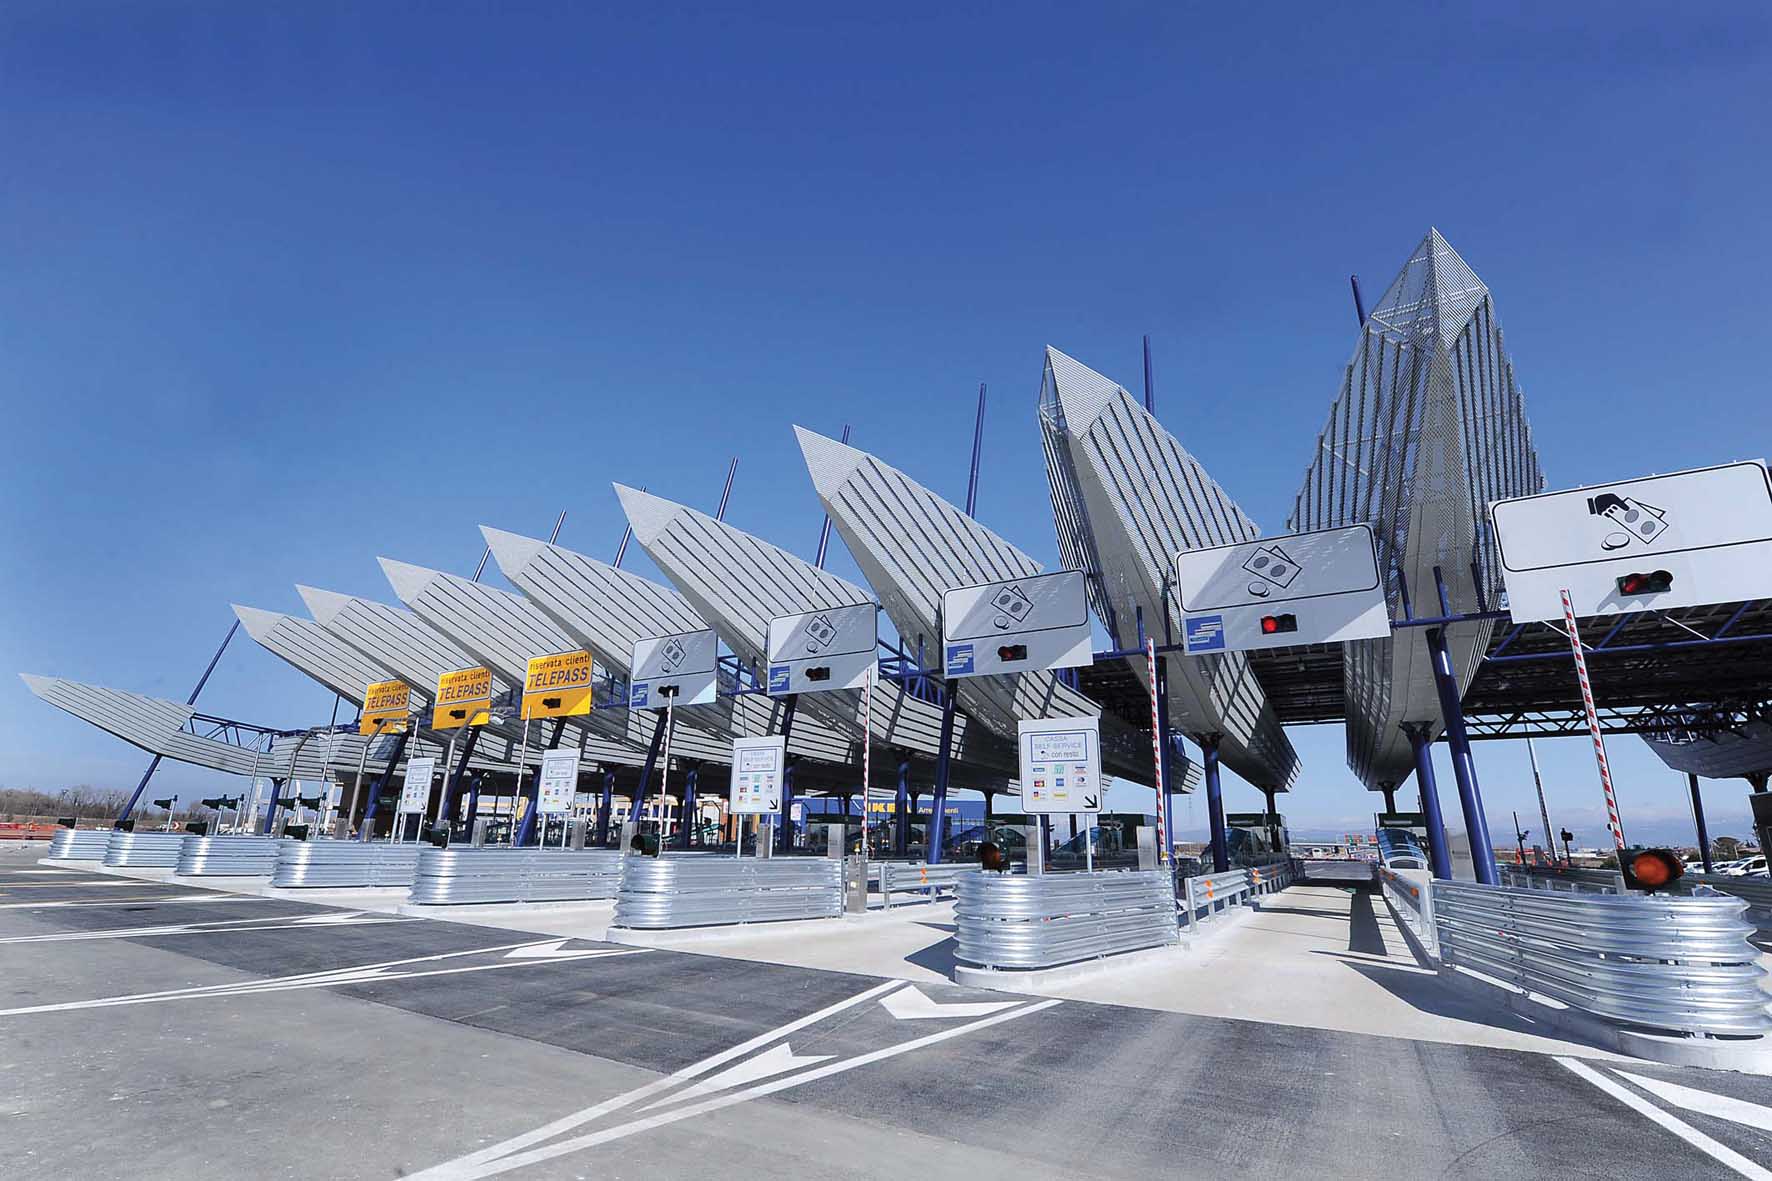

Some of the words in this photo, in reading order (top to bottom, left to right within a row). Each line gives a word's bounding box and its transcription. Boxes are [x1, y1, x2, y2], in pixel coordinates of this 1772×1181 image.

[566, 654, 590, 666] clienti
[529, 666, 589, 687] TELEPASS
[440, 681, 489, 700] TELEPASS
[367, 692, 408, 708] TELEPASS
